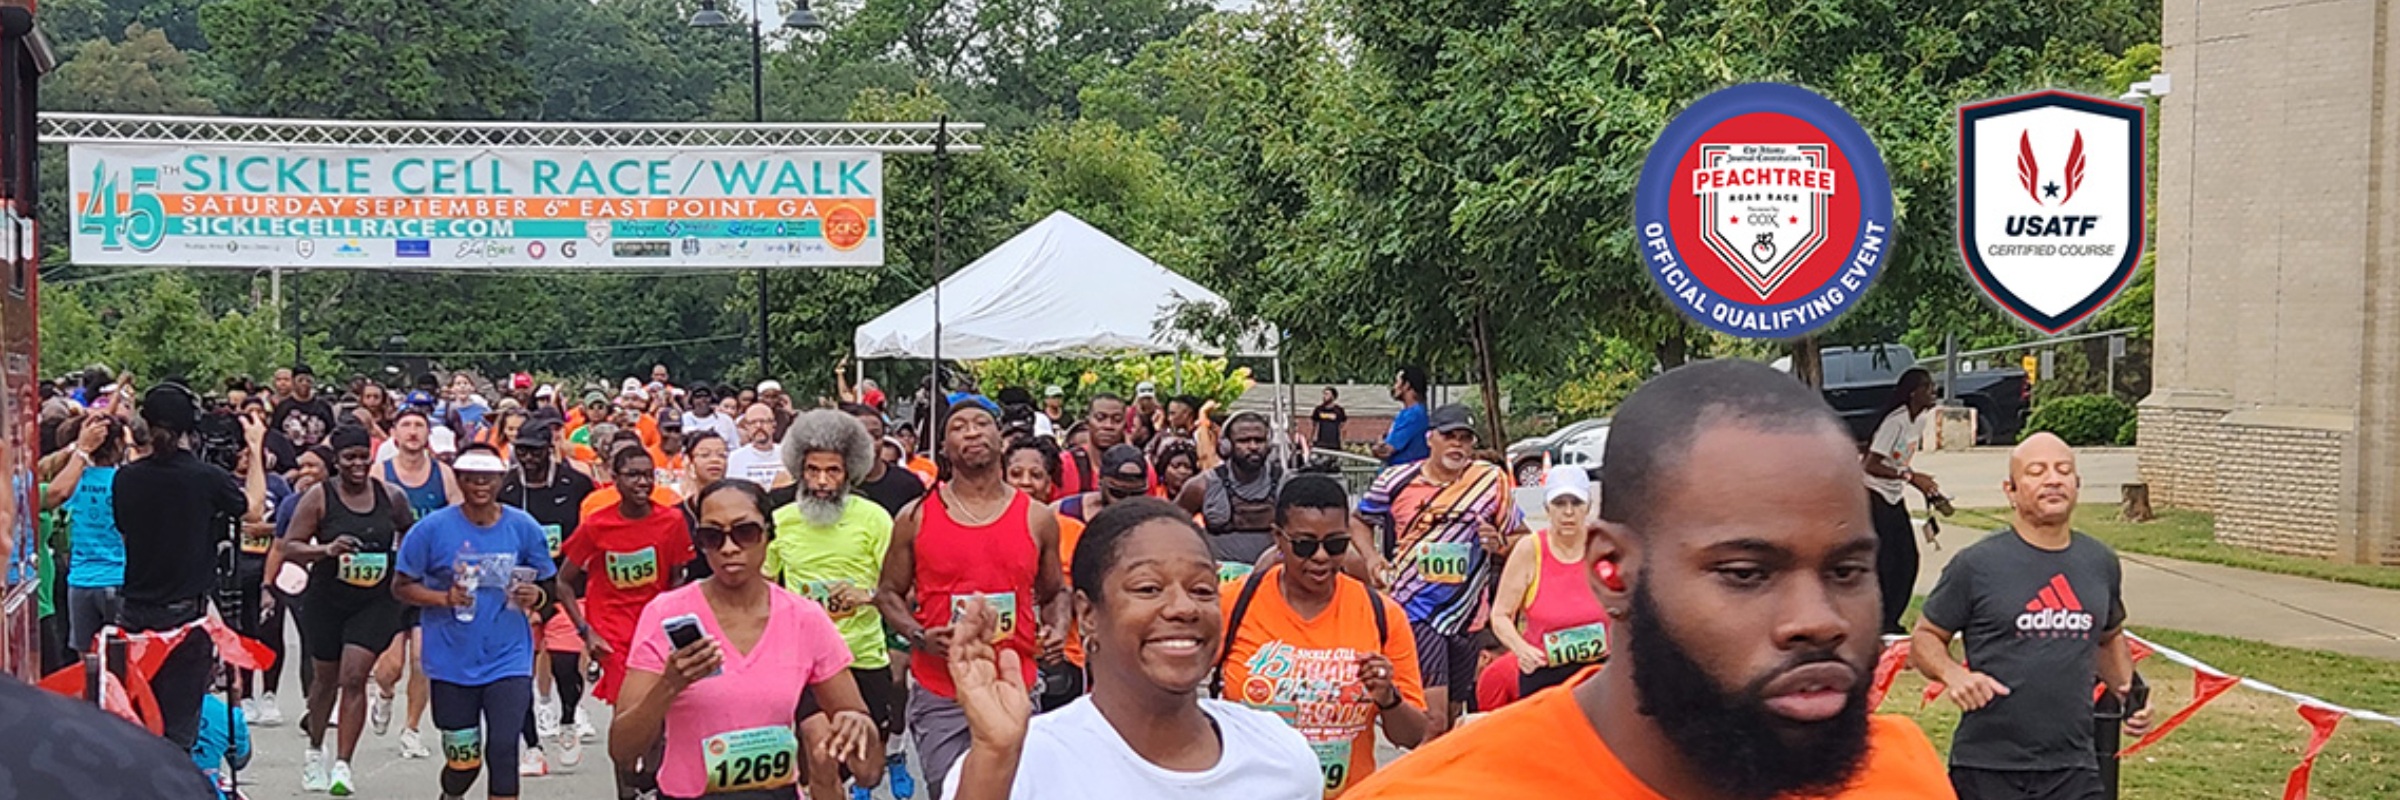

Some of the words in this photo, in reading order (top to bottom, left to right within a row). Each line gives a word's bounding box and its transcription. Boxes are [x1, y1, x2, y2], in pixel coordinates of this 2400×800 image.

[82, 157, 166, 252] 45
[182, 153, 371, 194] SICKLE
[391, 158, 513, 195] CELL
[181, 195, 345, 214] SATURDAY
[355, 198, 528, 217] SEPTEMBER
[580, 200, 650, 217] EAST
[666, 200, 765, 218] POINT,
[777, 200, 819, 217] GA
[181, 215, 515, 237] SICKLECELLRACE.COM
[343, 566, 383, 581] 1137
[610, 561, 653, 581] 1135
[1418, 557, 1468, 575] 1010
[2015, 607, 2093, 630] adidas
[1552, 638, 1603, 663] 1052
[714, 751, 790, 787] 1269
